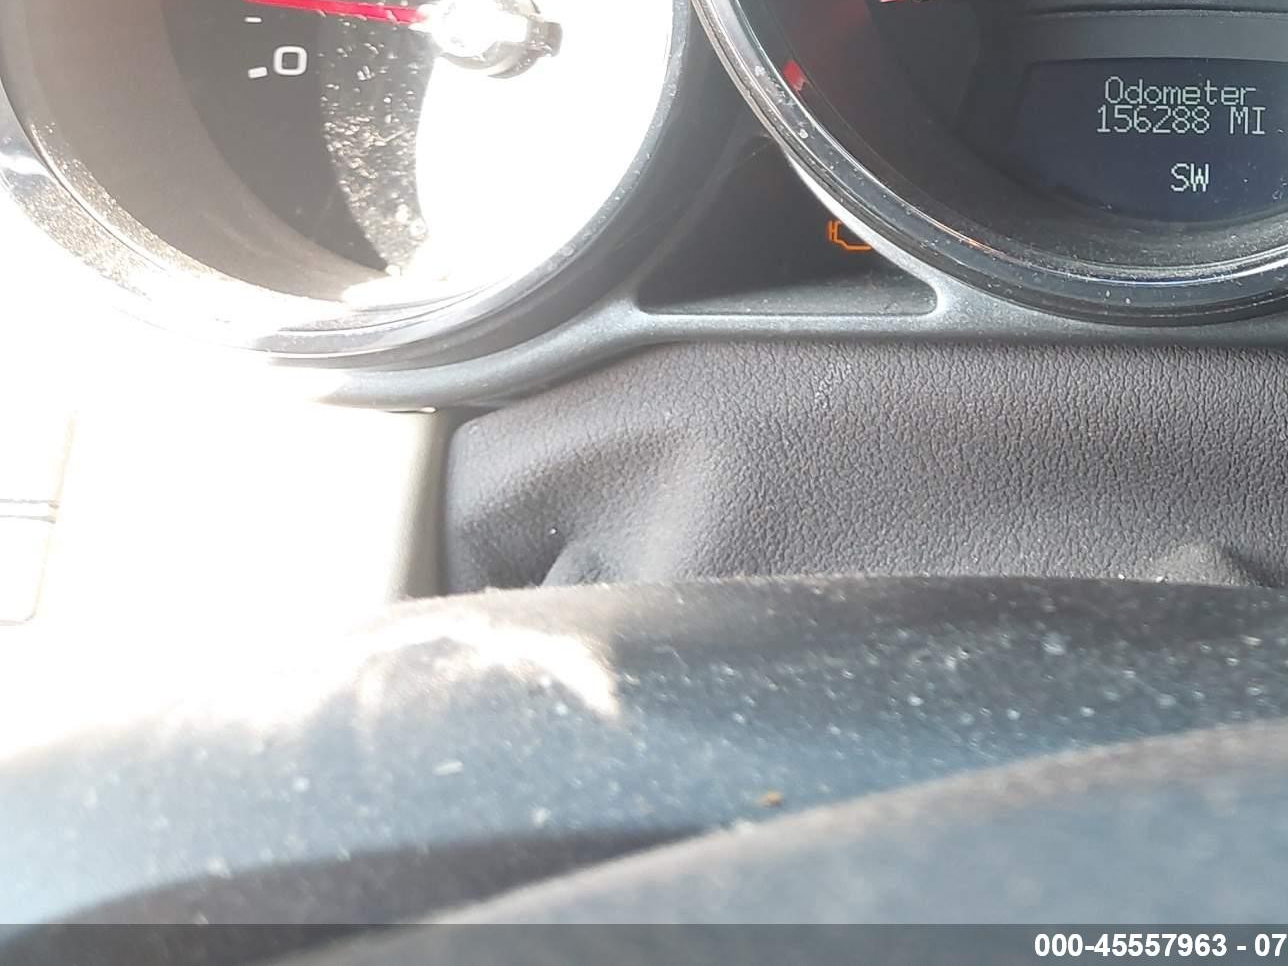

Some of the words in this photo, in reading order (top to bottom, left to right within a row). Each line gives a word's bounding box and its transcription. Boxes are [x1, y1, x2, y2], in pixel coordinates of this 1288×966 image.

[272, 45, 308, 77] 0
[1104, 76, 1257, 106] Odometer
[1096, 104, 1211, 135] 156288
[1229, 106, 1267, 135] MI
[1170, 162, 1210, 193] SW
